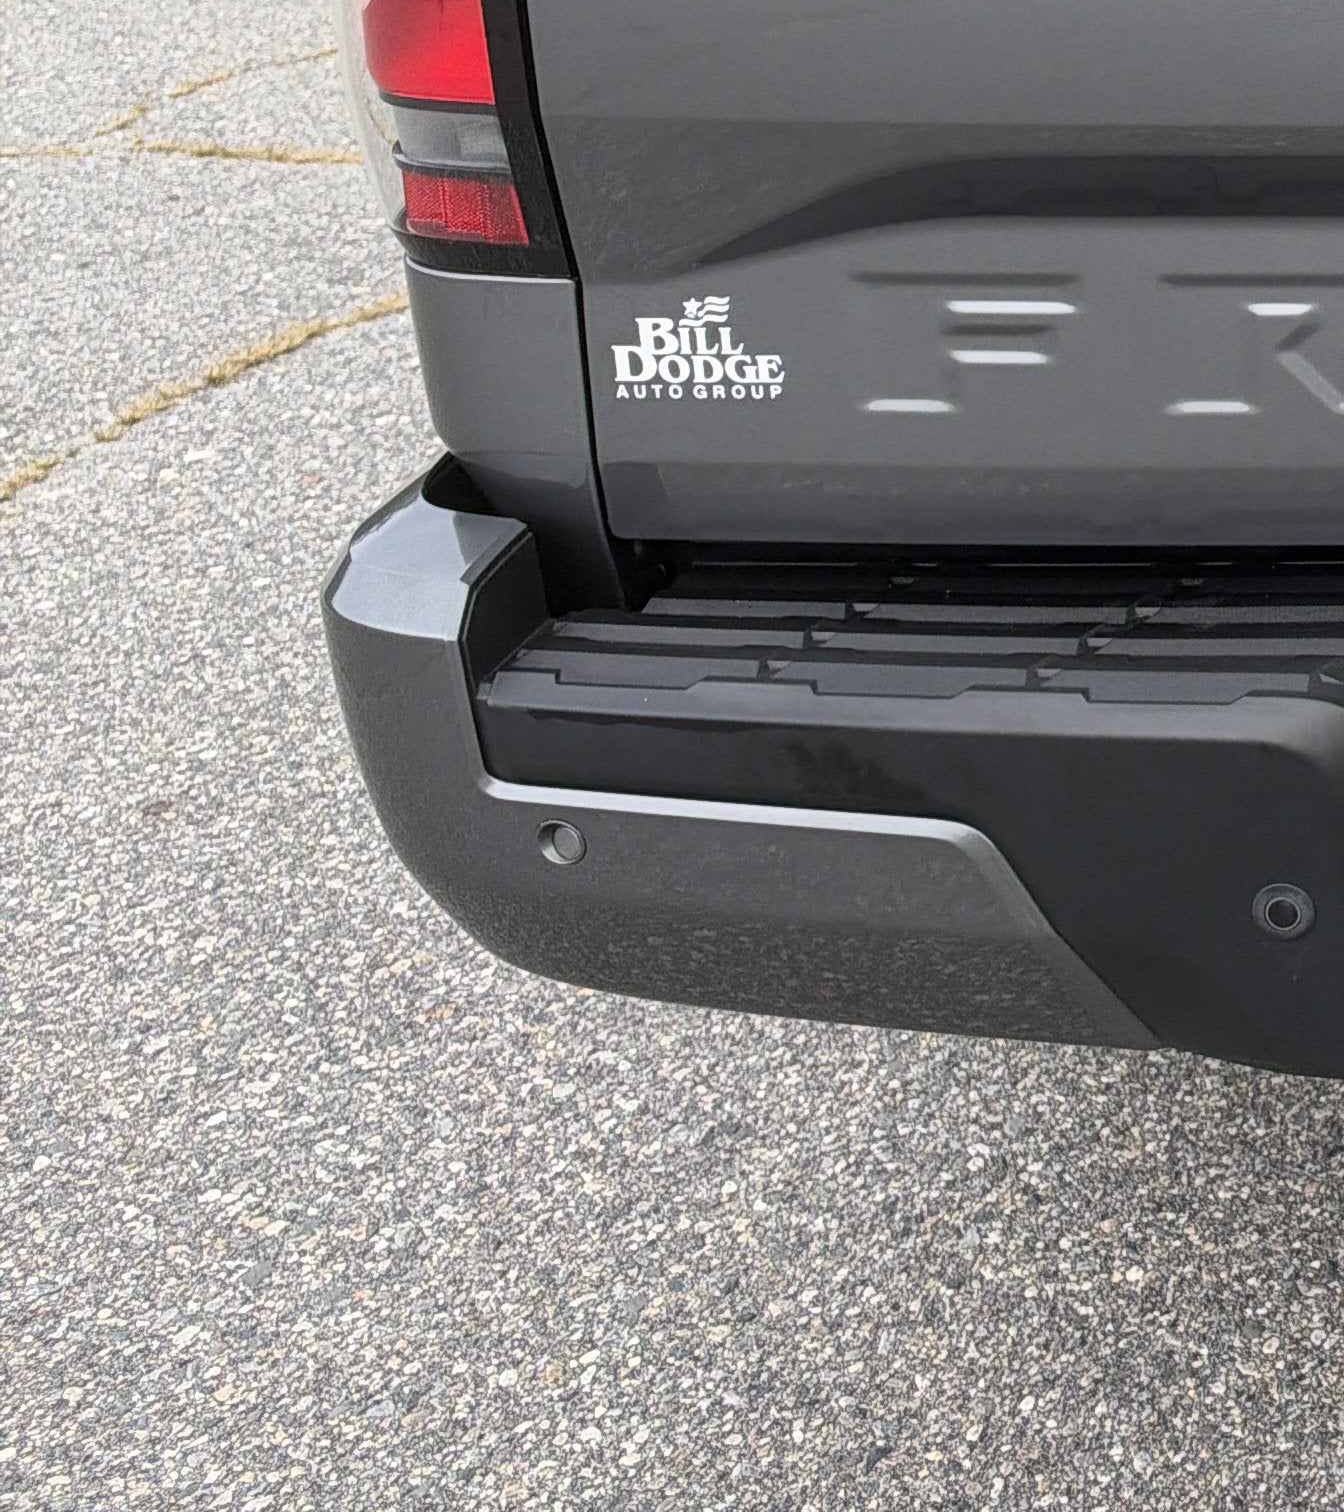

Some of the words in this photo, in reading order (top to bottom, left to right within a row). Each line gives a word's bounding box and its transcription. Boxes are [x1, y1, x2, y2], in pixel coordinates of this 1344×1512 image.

[634, 317, 745, 355] BILL
[610, 344, 786, 384] DODGE
[616, 384, 683, 400] AUTO
[692, 384, 783, 400] GROUP
